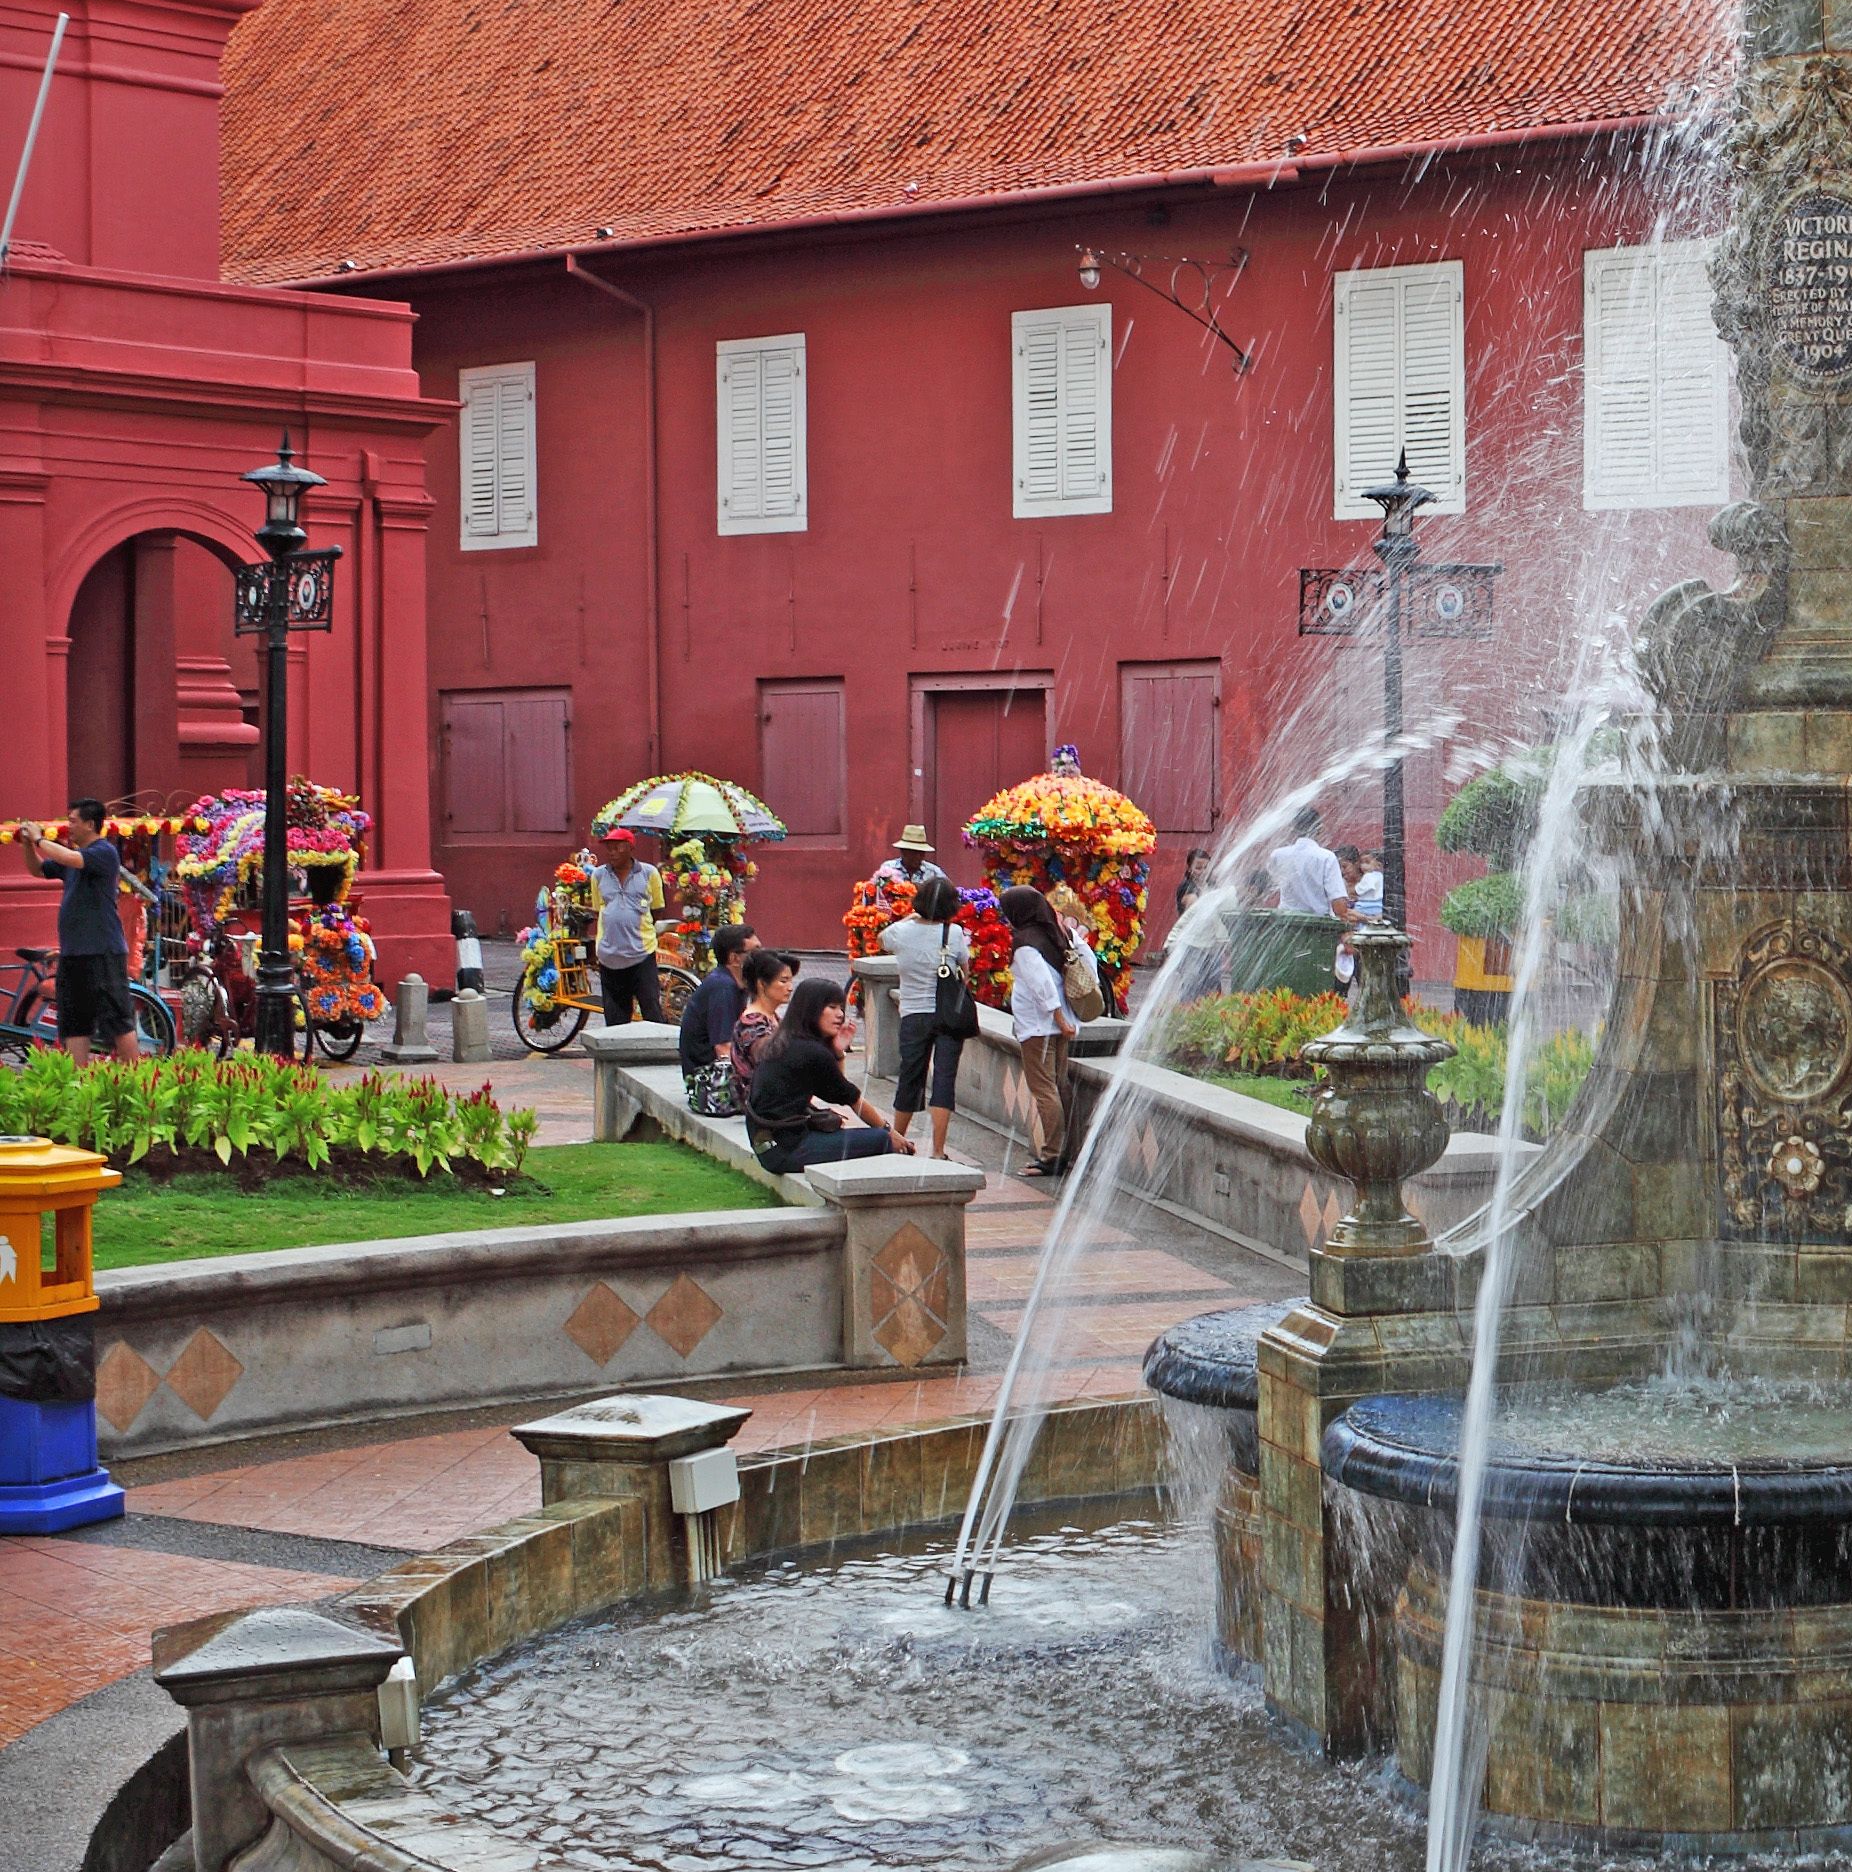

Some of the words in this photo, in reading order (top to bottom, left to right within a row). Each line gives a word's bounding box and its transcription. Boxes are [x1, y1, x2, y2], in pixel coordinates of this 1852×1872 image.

[1771, 288, 1826, 304] ERECTED
[1830, 287, 1847, 299] BY
[1811, 302, 1824, 313] OF
[1790, 316, 1843, 329] MEMORY
[1779, 330, 1820, 344] GREAT
[1804, 344, 1847, 366] 1904
